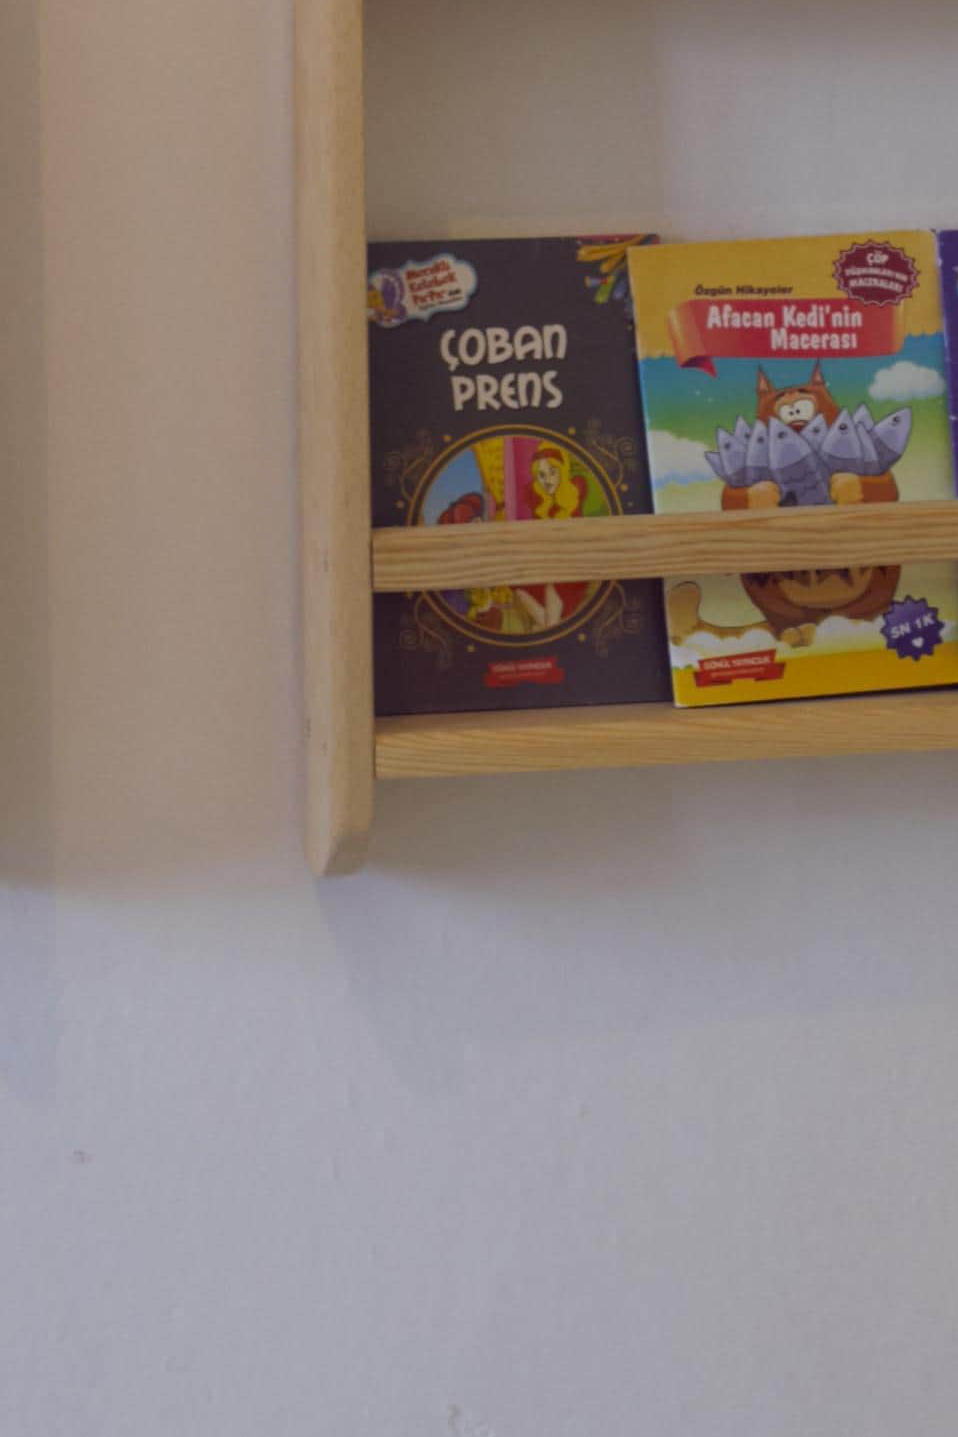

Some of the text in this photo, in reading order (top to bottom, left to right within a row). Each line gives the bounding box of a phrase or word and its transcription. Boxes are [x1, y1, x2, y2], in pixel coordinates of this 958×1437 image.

[866, 250, 889, 266] ÇÖP
[694, 284, 793, 297] Özgün Hikayeler
[707, 303, 862, 329] Afacan Kedi'nin
[440, 323, 568, 371] ÇOBAN
[770, 329, 857, 350] Macerası
[451, 370, 563, 411] PRENS
